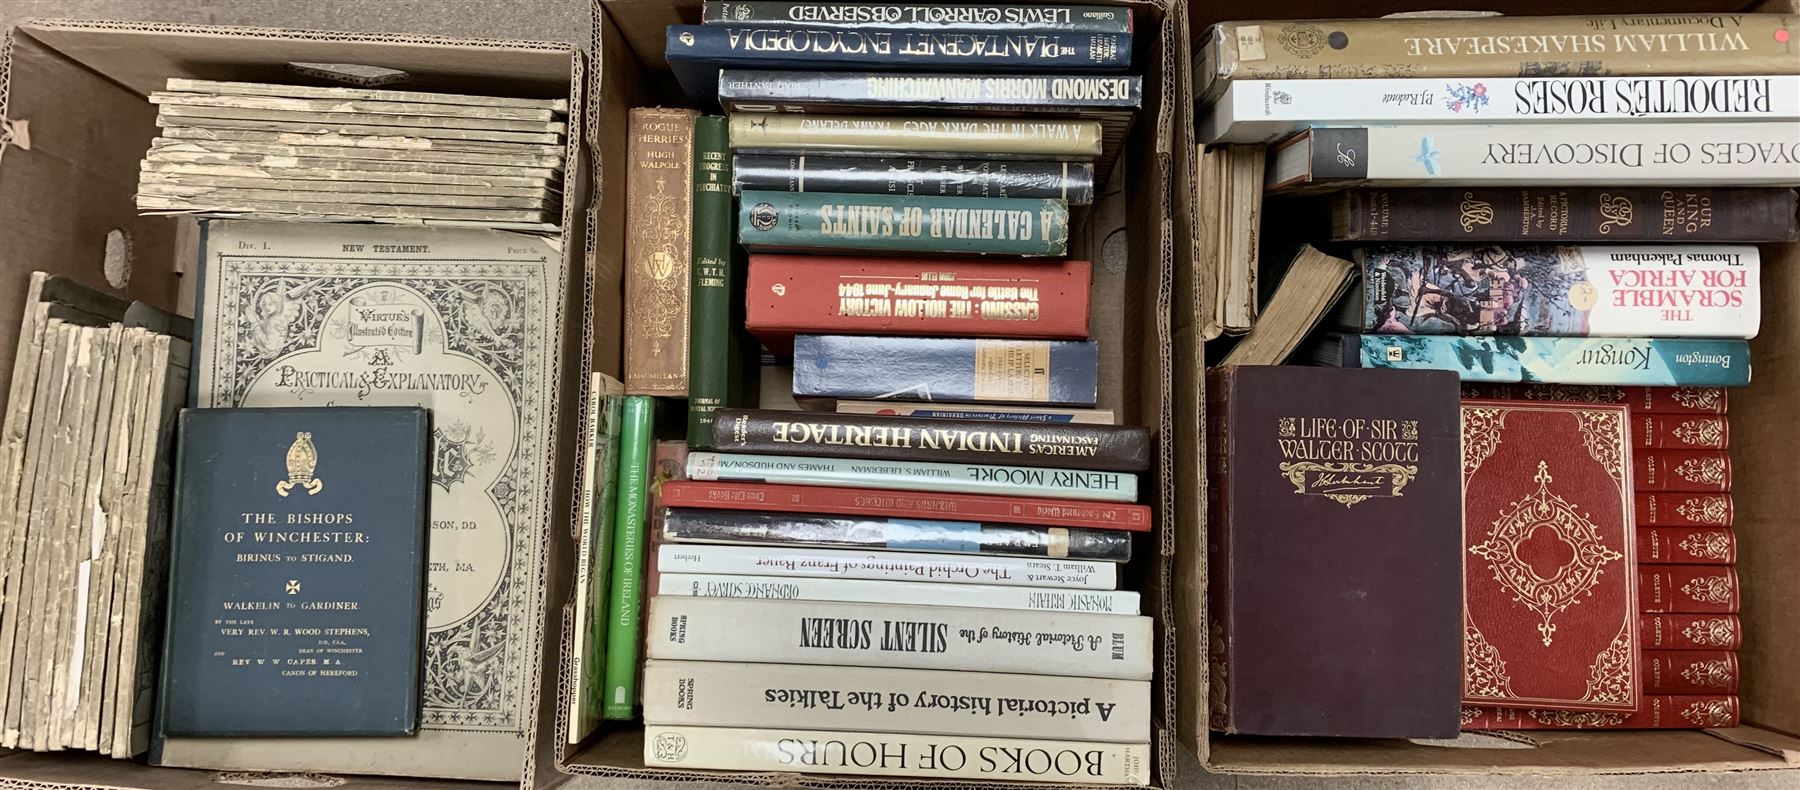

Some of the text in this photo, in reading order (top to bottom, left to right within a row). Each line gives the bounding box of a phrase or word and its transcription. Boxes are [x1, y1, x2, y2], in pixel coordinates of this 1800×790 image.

[788, 5, 1070, 23] LEWIS CARROLL OBSERVED
[1083, 11, 1115, 20] Guiliano
[1585, 14, 1743, 30] A Documentary Life
[725, 28, 1076, 57] THE PLANTAGENET ENCYCLOPEDIA
[1404, 31, 1750, 57] WILLIAM SHAKESPEARE
[867, 77, 1130, 100] DESMOND MORRIS MANWATCHING
[1514, 78, 1774, 117] REDOUTÉ'S ROSES
[642, 122, 680, 132] ROGUE
[851, 120, 891, 132] FRANK
[940, 122, 978, 137] DARK
[983, 122, 1007, 138] THE
[1011, 123, 1025, 138] IN
[1029, 123, 1069, 139] WALK
[1072, 125, 1082, 139] A
[639, 134, 684, 143] HERRIES
[703, 152, 726, 160] RECENT
[1481, 142, 1691, 168] OF DISCOVERY
[640, 161, 680, 169] WALPOLE
[698, 162, 728, 171] PROGRESS
[709, 173, 717, 181] IN
[820, 204, 893, 237] SAINTS
[1550, 194, 1558, 231] RECORD
[1559, 197, 1569, 235] PICTORIAL
[1661, 191, 1674, 236] QUEEN
[1676, 200, 1684, 225] AND
[1685, 192, 1698, 234] KING
[1700, 198, 1711, 228] OUR
[899, 206, 922, 238] OF
[930, 208, 1033, 241] CALENDAR
[1040, 211, 1053, 240] A
[342, 244, 431, 253] NEW TESTAMENT.
[1610, 253, 1743, 266] Thomas Pakenham
[698, 278, 724, 287] FLEMING
[1608, 269, 1747, 288] FOR AFRICA
[838, 283, 865, 297] 1944
[940, 285, 969, 300] Rome
[969, 286, 986, 300] for
[987, 286, 1018, 301] Battle
[1020, 287, 1039, 302] The
[1612, 289, 1742, 307] SCRAMBLE
[838, 297, 972, 318] THE HOLLOW VICTORY
[1660, 309, 1693, 321] THE
[368, 348, 394, 366] A
[1576, 343, 1731, 371] Bonington Kongur
[275, 365, 488, 394] PRACTICAL EXPLANATORY
[588, 391, 598, 448] CAROL BARKER
[1006, 413, 1030, 421] History
[741, 415, 749, 447] Reader's
[1370, 419, 1398, 440] SIR
[773, 422, 1098, 456] AMERICA'S INDIAN HERITAGE
[1030, 434, 1099, 444] FASCINATING
[1278, 439, 1419, 462] WALTER SCOTT
[775, 462, 836, 473] THAMES AND
[850, 465, 951, 477] WILLIAM LIEBERMAN
[1647, 455, 1655, 485] COLETTE
[967, 467, 1119, 489] HENRY MOORE
[241, 513, 353, 524] THE BISHOPS
[224, 532, 370, 543] OF WINCHESTER:
[579, 490, 592, 584] HOW THE WORLD BEGAN
[620, 462, 640, 626] THE MONASTERIES OF IRELAND
[236, 553, 354, 563] BIRINUS STIGAND.
[673, 553, 702, 562] Herbert
[800, 559, 839, 573] Franz
[929, 566, 980, 579] Orchid
[983, 567, 1011, 581] The
[1026, 562, 1096, 573] William T. Stearn
[1035, 574, 1089, 584] Joyce Stewart
[704, 582, 744, 599] SURVEY
[224, 602, 280, 610] WALKELIN
[1028, 592, 1113, 612] MONASTIC BRITAIN
[221, 628, 370, 637] VERY WOOD STEPHENS,
[670, 616, 678, 642] BOOKS
[678, 615, 688, 644] SPRING
[799, 617, 1103, 653] A Pictorial History of the SILENT SCREEN
[1112, 632, 1124, 660] BLUM
[570, 657, 580, 705] Grasshopper
[678, 679, 686, 709] BOOKS
[686, 679, 694, 710] SPRING
[764, 689, 1116, 722] A pictorial history of the Talkies
[777, 738, 1104, 776] BOOKS OF HOURS
